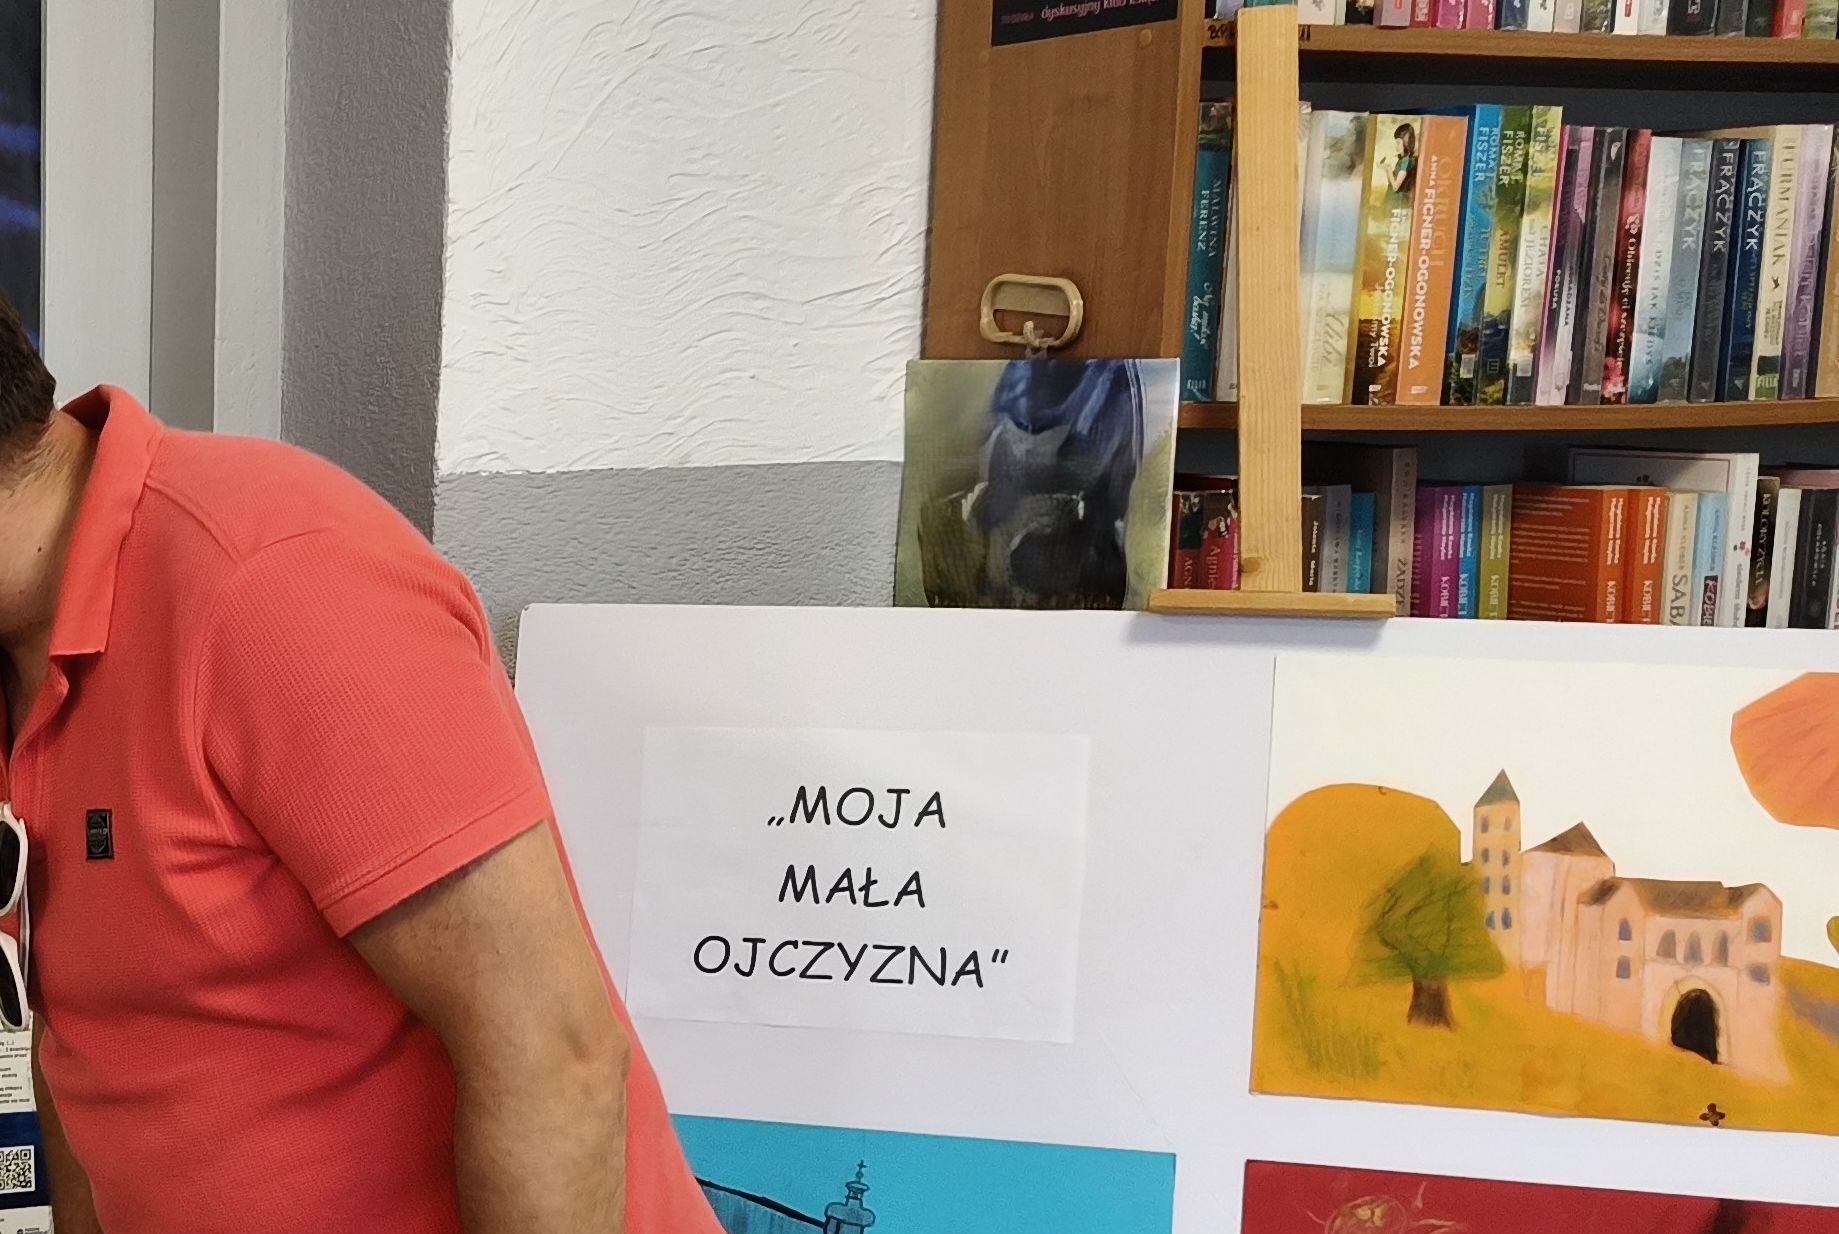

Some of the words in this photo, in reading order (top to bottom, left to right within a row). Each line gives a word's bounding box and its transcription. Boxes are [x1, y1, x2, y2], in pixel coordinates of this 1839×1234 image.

[1475, 126, 1490, 182] FISZER
[1498, 130, 1514, 186] FISZER
[1197, 190, 1210, 251] FERENZ
[1208, 177, 1222, 257] MALWINA
[1432, 157, 1455, 267] OKRUCH
[1713, 152, 1734, 253] FRĄCZYK
[1745, 150, 1766, 251] FRĄCZYK
[1408, 188, 1436, 369] FICNER-OGONOWSKA
[1495, 228, 1510, 289] AMULET
[1519, 237, 1535, 309] JEZIOREM
[1536, 225, 1548, 278] CHATA
[1376, 208, 1403, 367] FICNER-OGONOWSKA
[1183, 556, 1193, 589] AGN
[1210, 546, 1221, 589] Agnie
[1702, 579, 1717, 626] KOBIE
[767, 785, 946, 829] „MOJA
[778, 864, 925, 908] MAŁA
